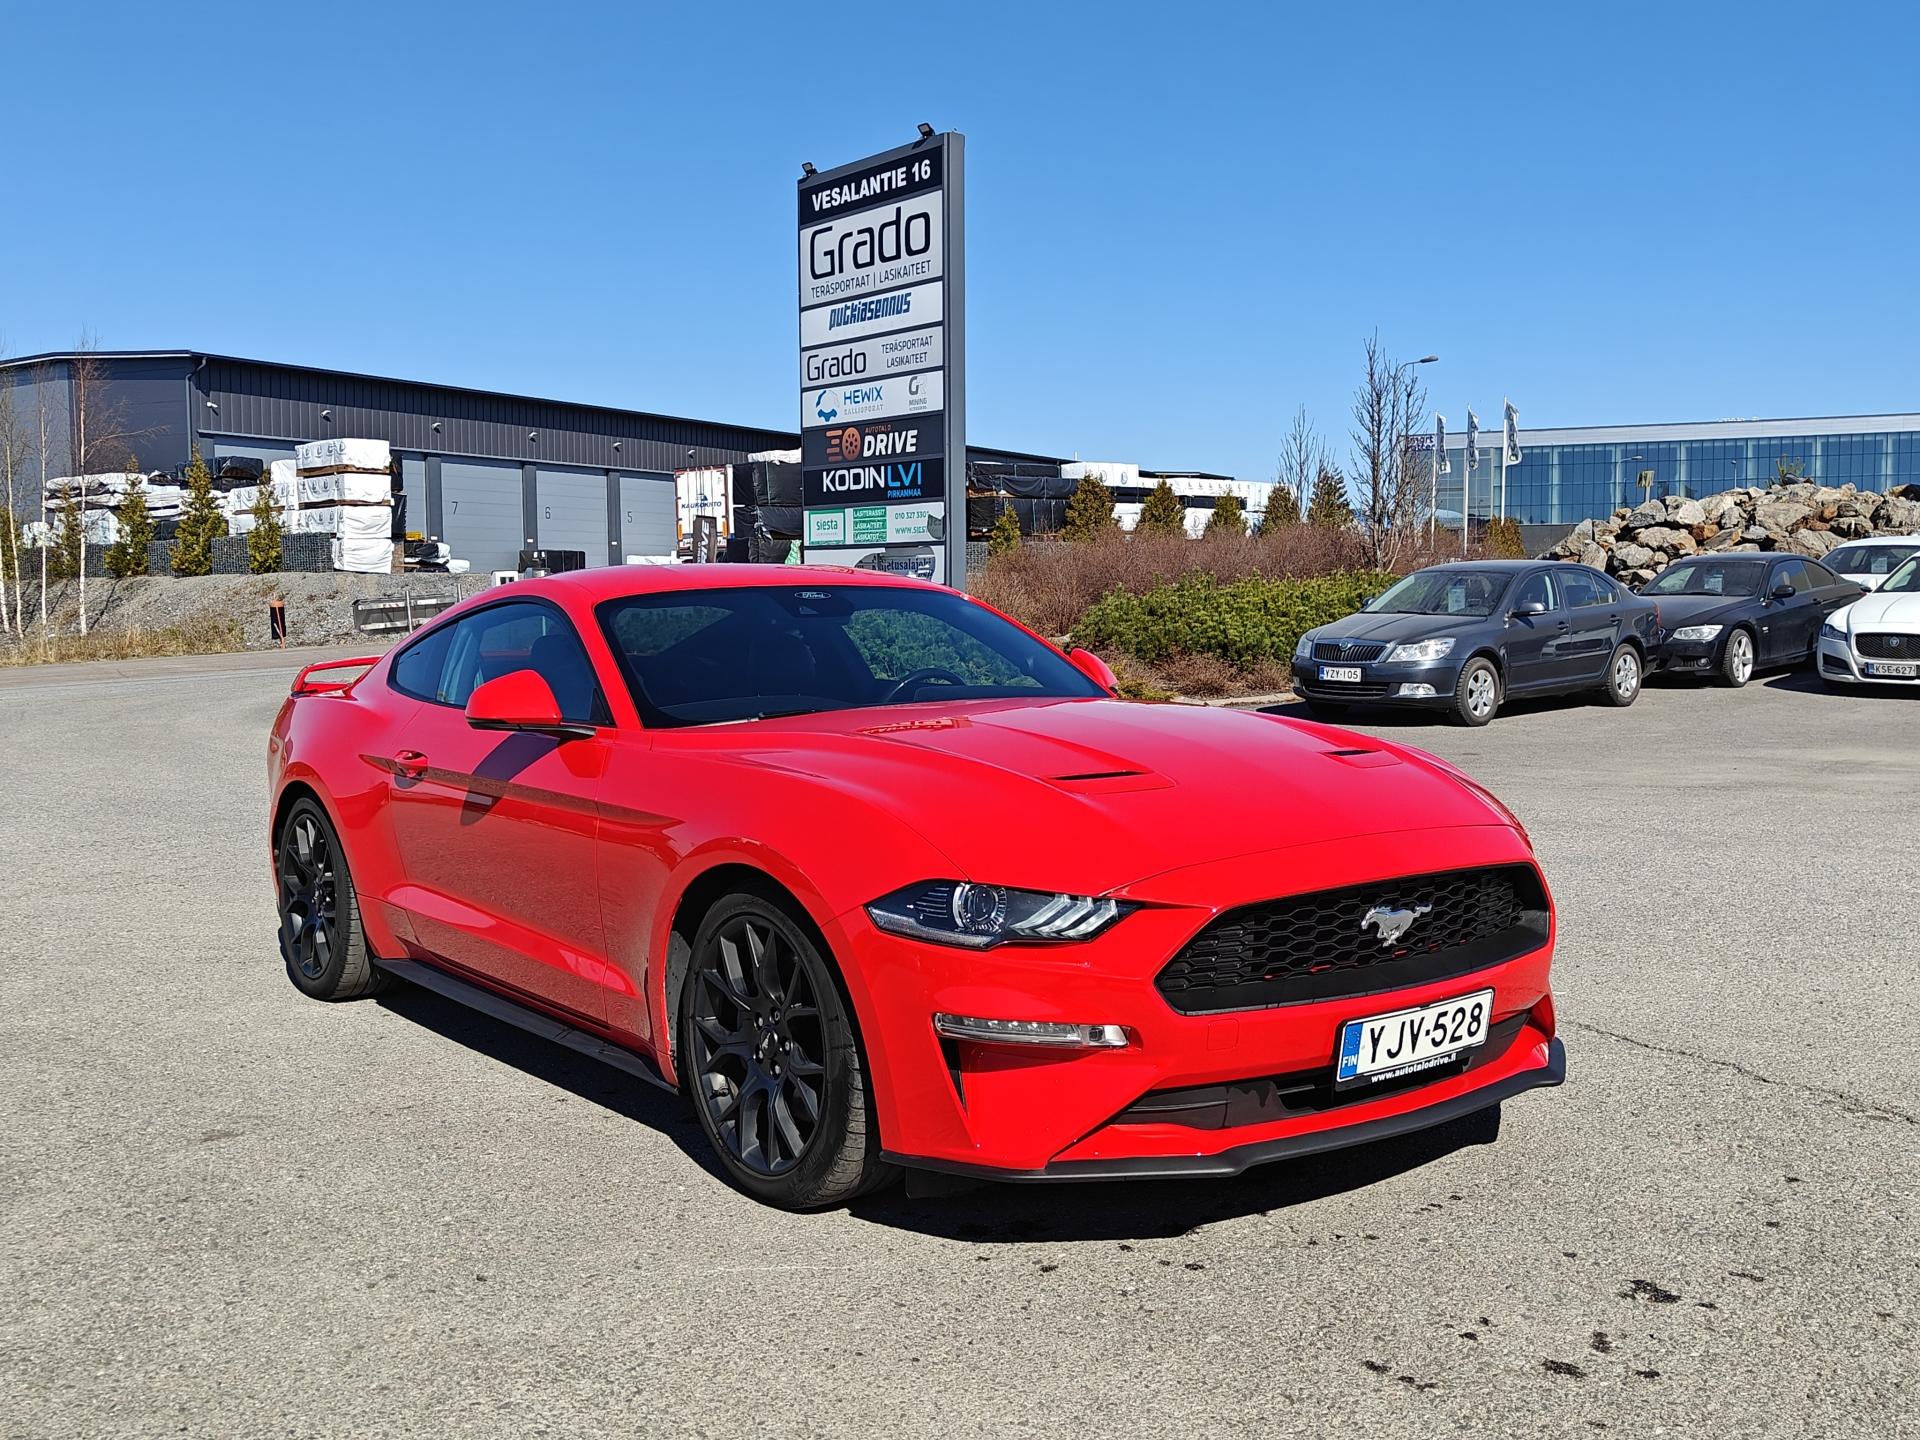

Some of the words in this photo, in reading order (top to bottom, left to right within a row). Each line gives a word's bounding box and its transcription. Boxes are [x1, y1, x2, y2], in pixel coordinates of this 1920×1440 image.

[812, 166, 907, 212] VESALANTIE
[911, 159, 931, 182] 16
[809, 206, 931, 280] Grado
[811, 274, 871, 299] TERÄSPORTAAT
[879, 260, 931, 283] LASIKAITEET
[829, 292, 912, 331] putkiasennus
[881, 335, 934, 354] TERÄSPORTAAT
[806, 348, 867, 381] Grado
[886, 352, 928, 369] LASIKAITEET
[844, 385, 883, 405] HEWIX
[863, 429, 918, 458] DRIVE
[887, 488, 922, 498] PIRKANMAA
[452, 501, 458, 515] 7
[545, 506, 551, 519] 6
[627, 511, 633, 523] 5
[816, 519, 838, 531] siesta
[1325, 669, 1359, 680] YZY-105
[1875, 664, 1913, 675] KSE-627
[1369, 1002, 1483, 1064] YJV-528
[1341, 1054, 1359, 1068] FIN
[1371, 1053, 1457, 1083] www.autotalodrive.fi
